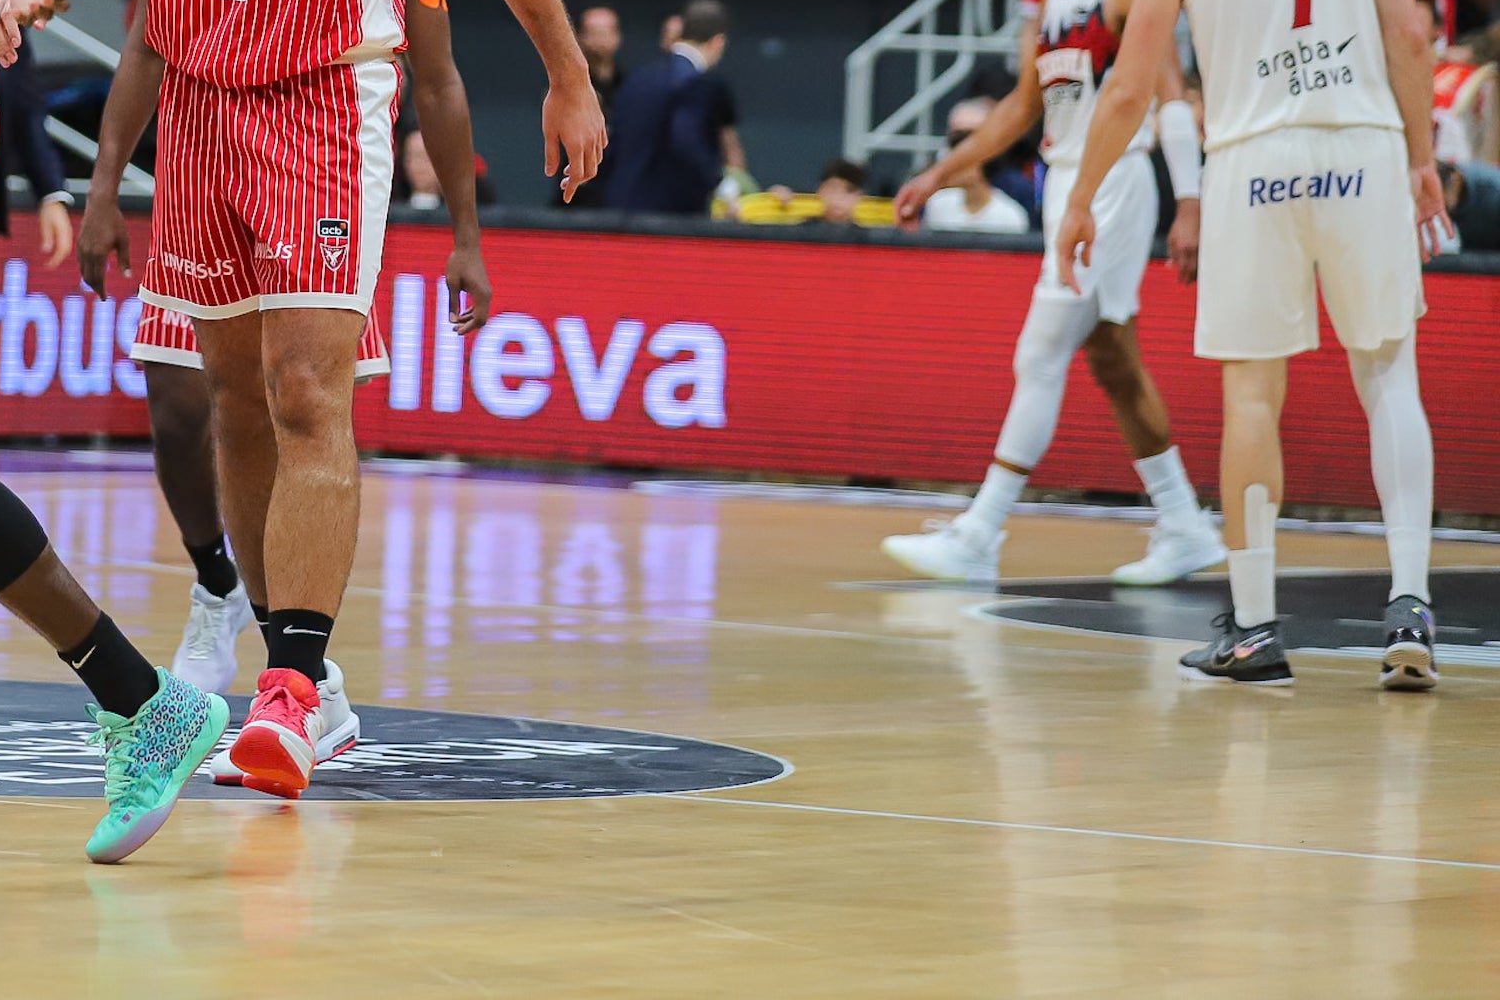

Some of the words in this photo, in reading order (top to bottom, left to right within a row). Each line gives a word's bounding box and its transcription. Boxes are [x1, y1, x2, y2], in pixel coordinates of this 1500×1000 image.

[1257, 40, 1331, 79] araba
[1250, 168, 1364, 207] Recalvi
[321, 226, 342, 236] acb
[388, 272, 728, 428] lleva
